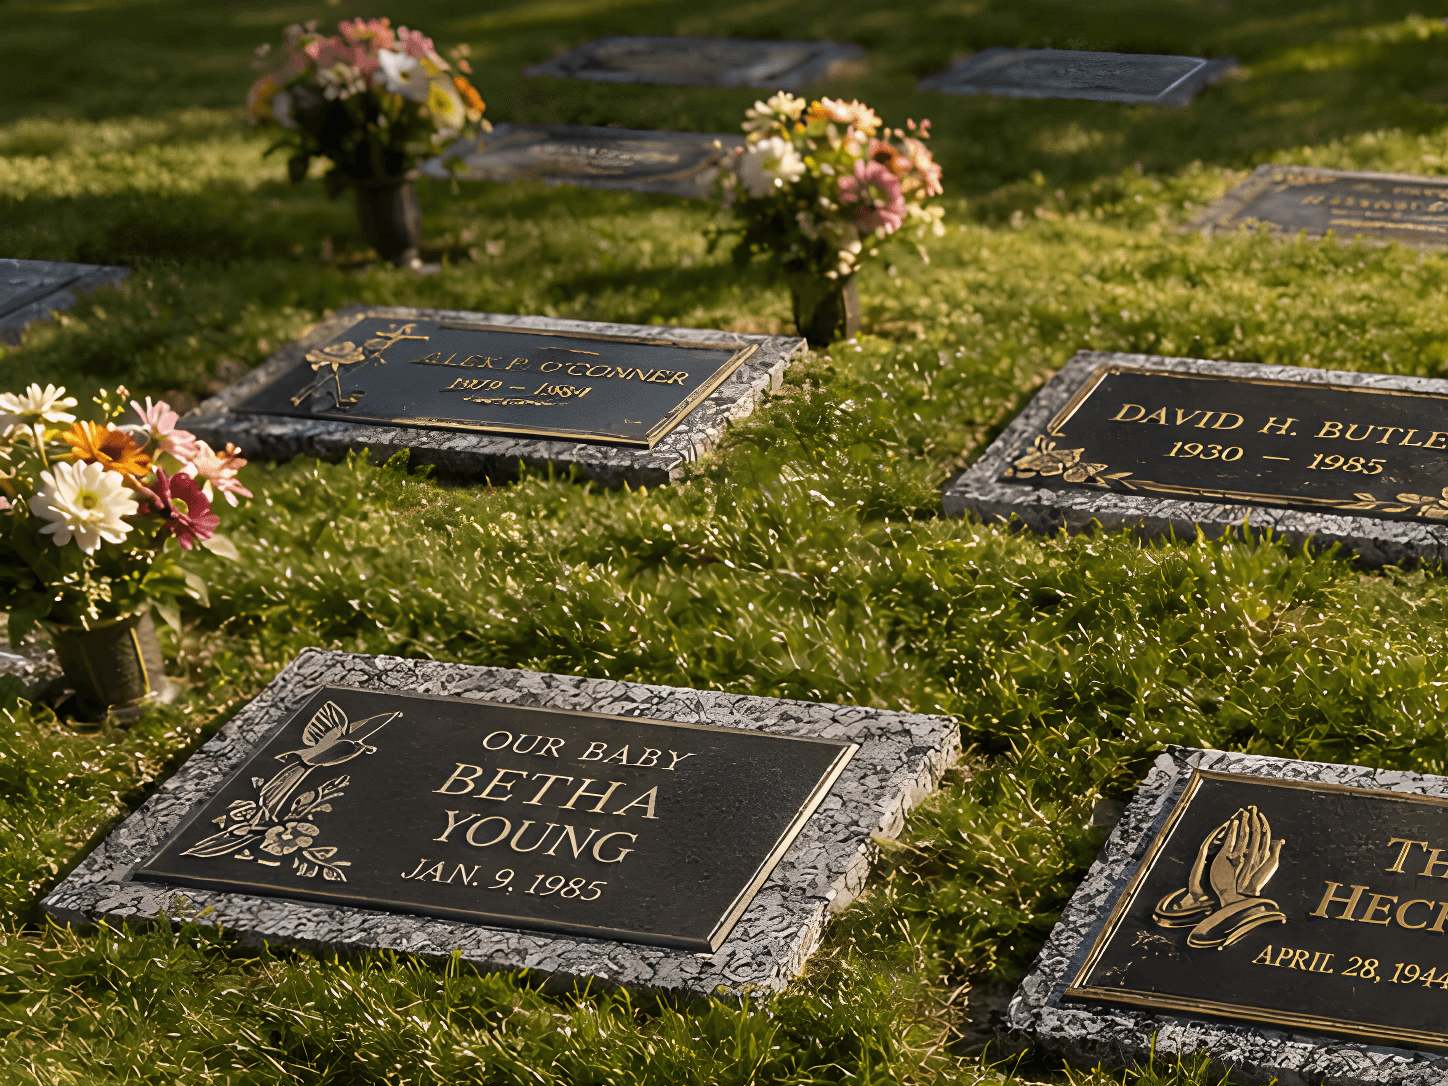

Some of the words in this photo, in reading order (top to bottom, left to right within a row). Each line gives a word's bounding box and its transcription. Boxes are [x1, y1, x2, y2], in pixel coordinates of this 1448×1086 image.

[540, 360, 689, 386] O'CONNER
[1108, 403, 1244, 430] DAVID
[1258, 416, 1299, 436] H.
[1163, 441, 1244, 462] 1930
[1306, 453, 1388, 476] 1985
[482, 730, 566, 758] OUR
[577, 741, 697, 771] BABY
[431, 762, 660, 820] BETHA
[432, 810, 639, 863] YOUNG
[400, 858, 482, 887] JAN.
[524, 874, 608, 901] 1985
[1251, 944, 1336, 974] APRIL
[1341, 955, 1381, 984] 28,
